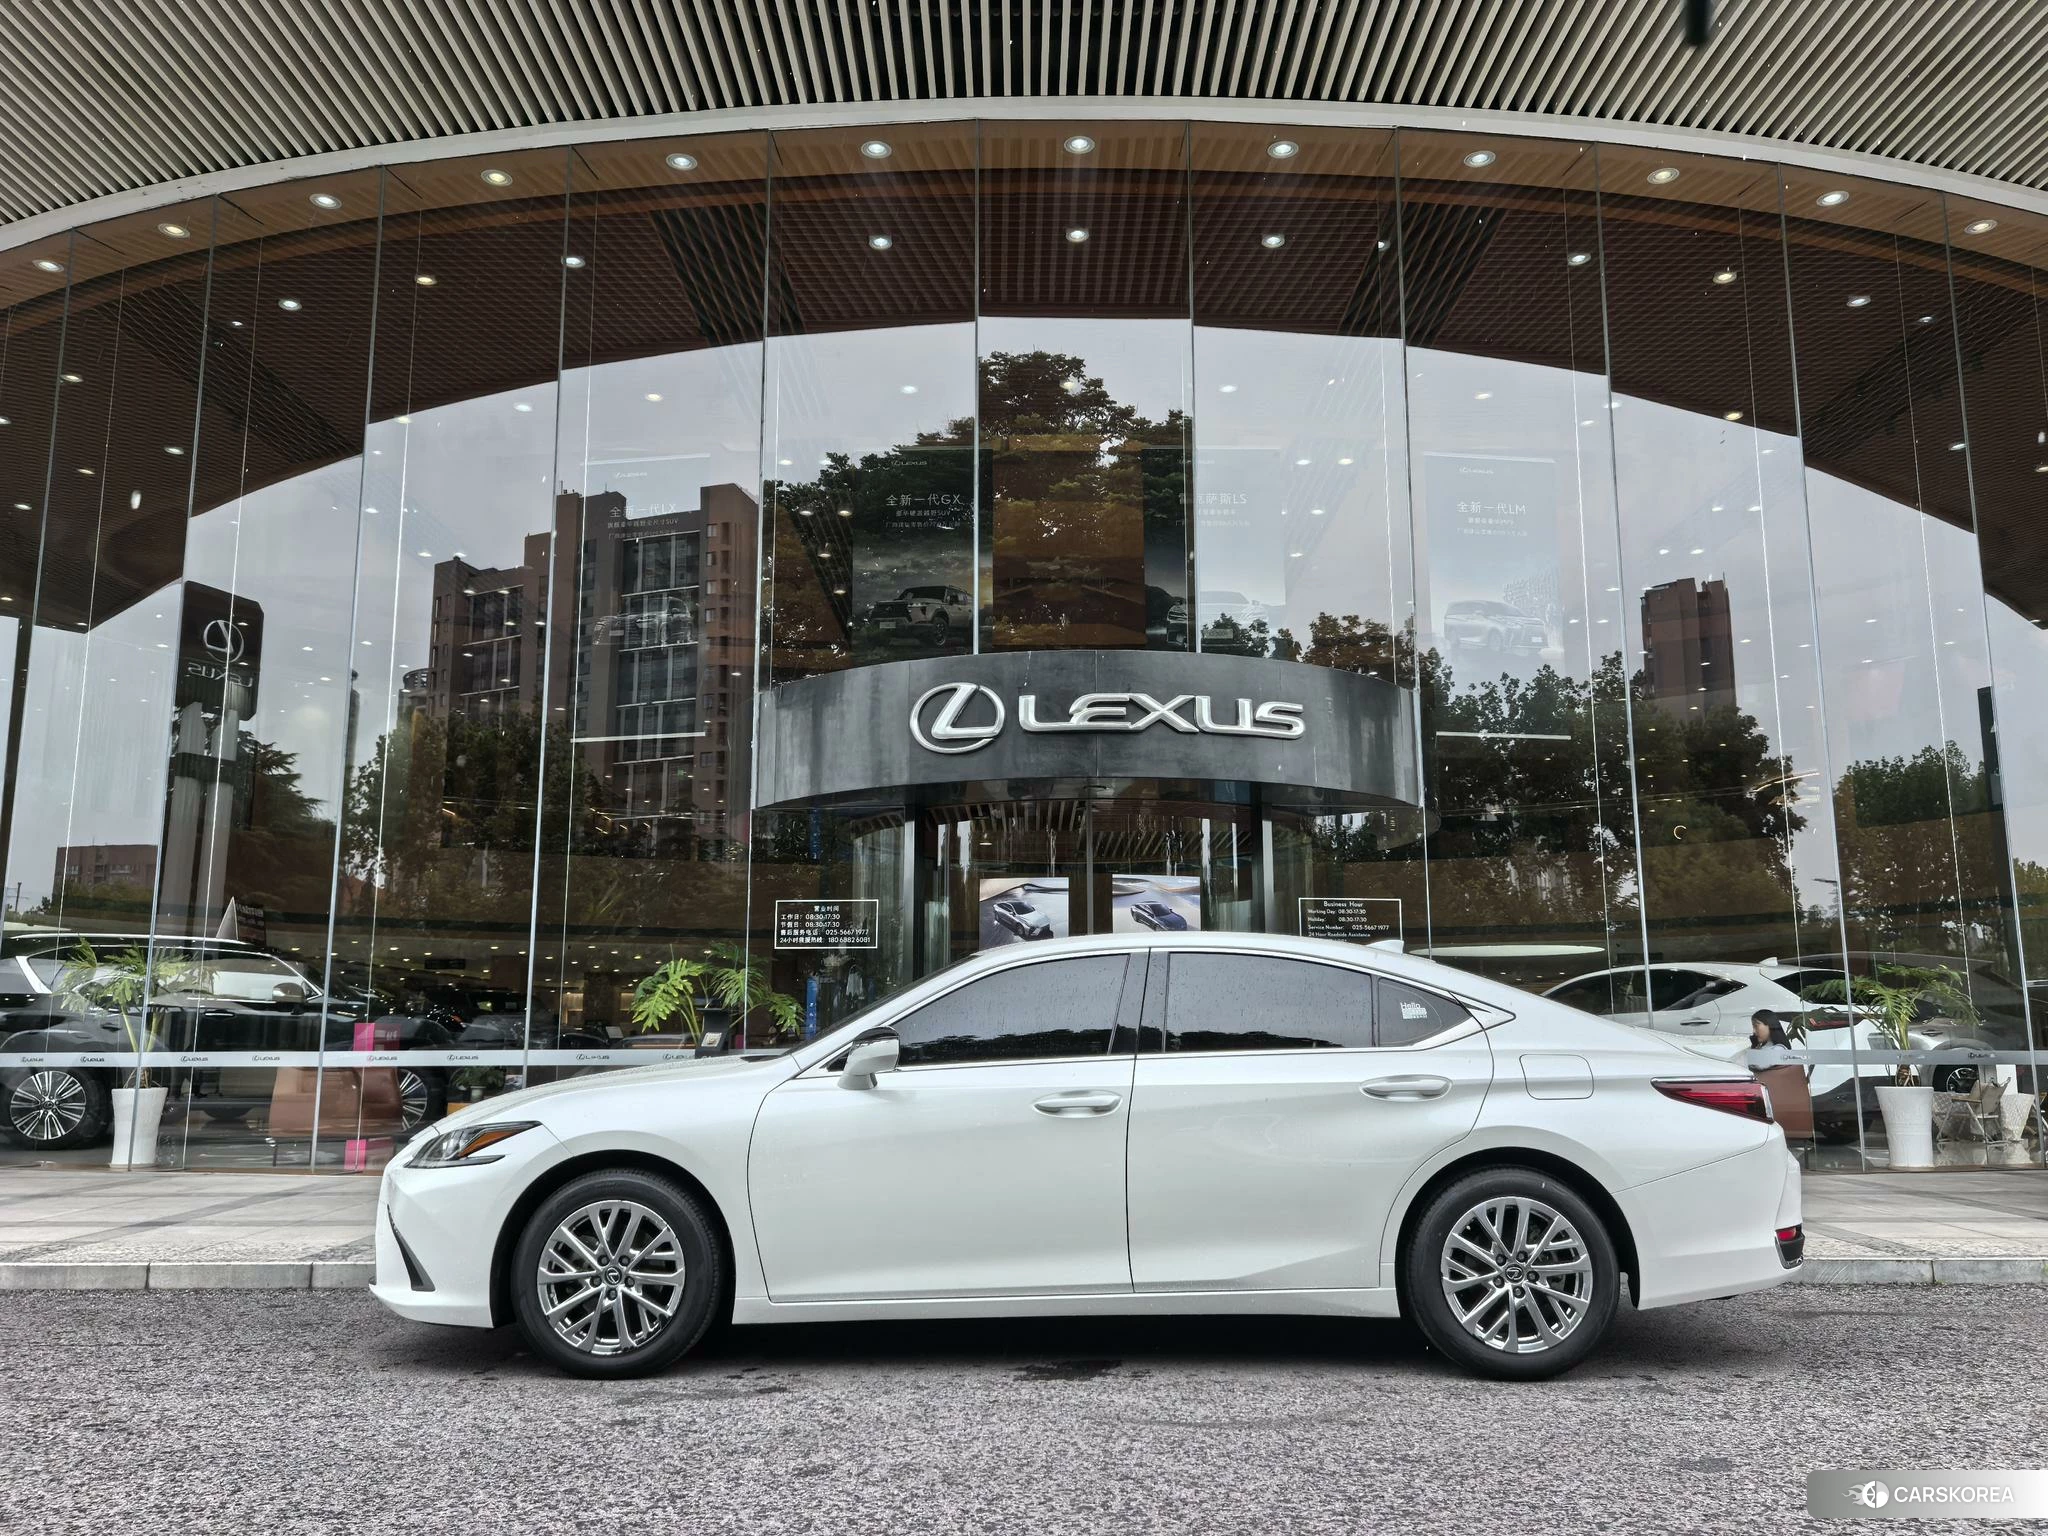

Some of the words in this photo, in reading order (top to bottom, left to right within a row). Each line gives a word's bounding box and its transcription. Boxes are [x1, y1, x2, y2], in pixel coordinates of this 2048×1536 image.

[886, 494, 961, 506] 全新一代GX
[1457, 501, 1526, 515] 全新一代LM
[1019, 693, 1305, 739] LEXUS
